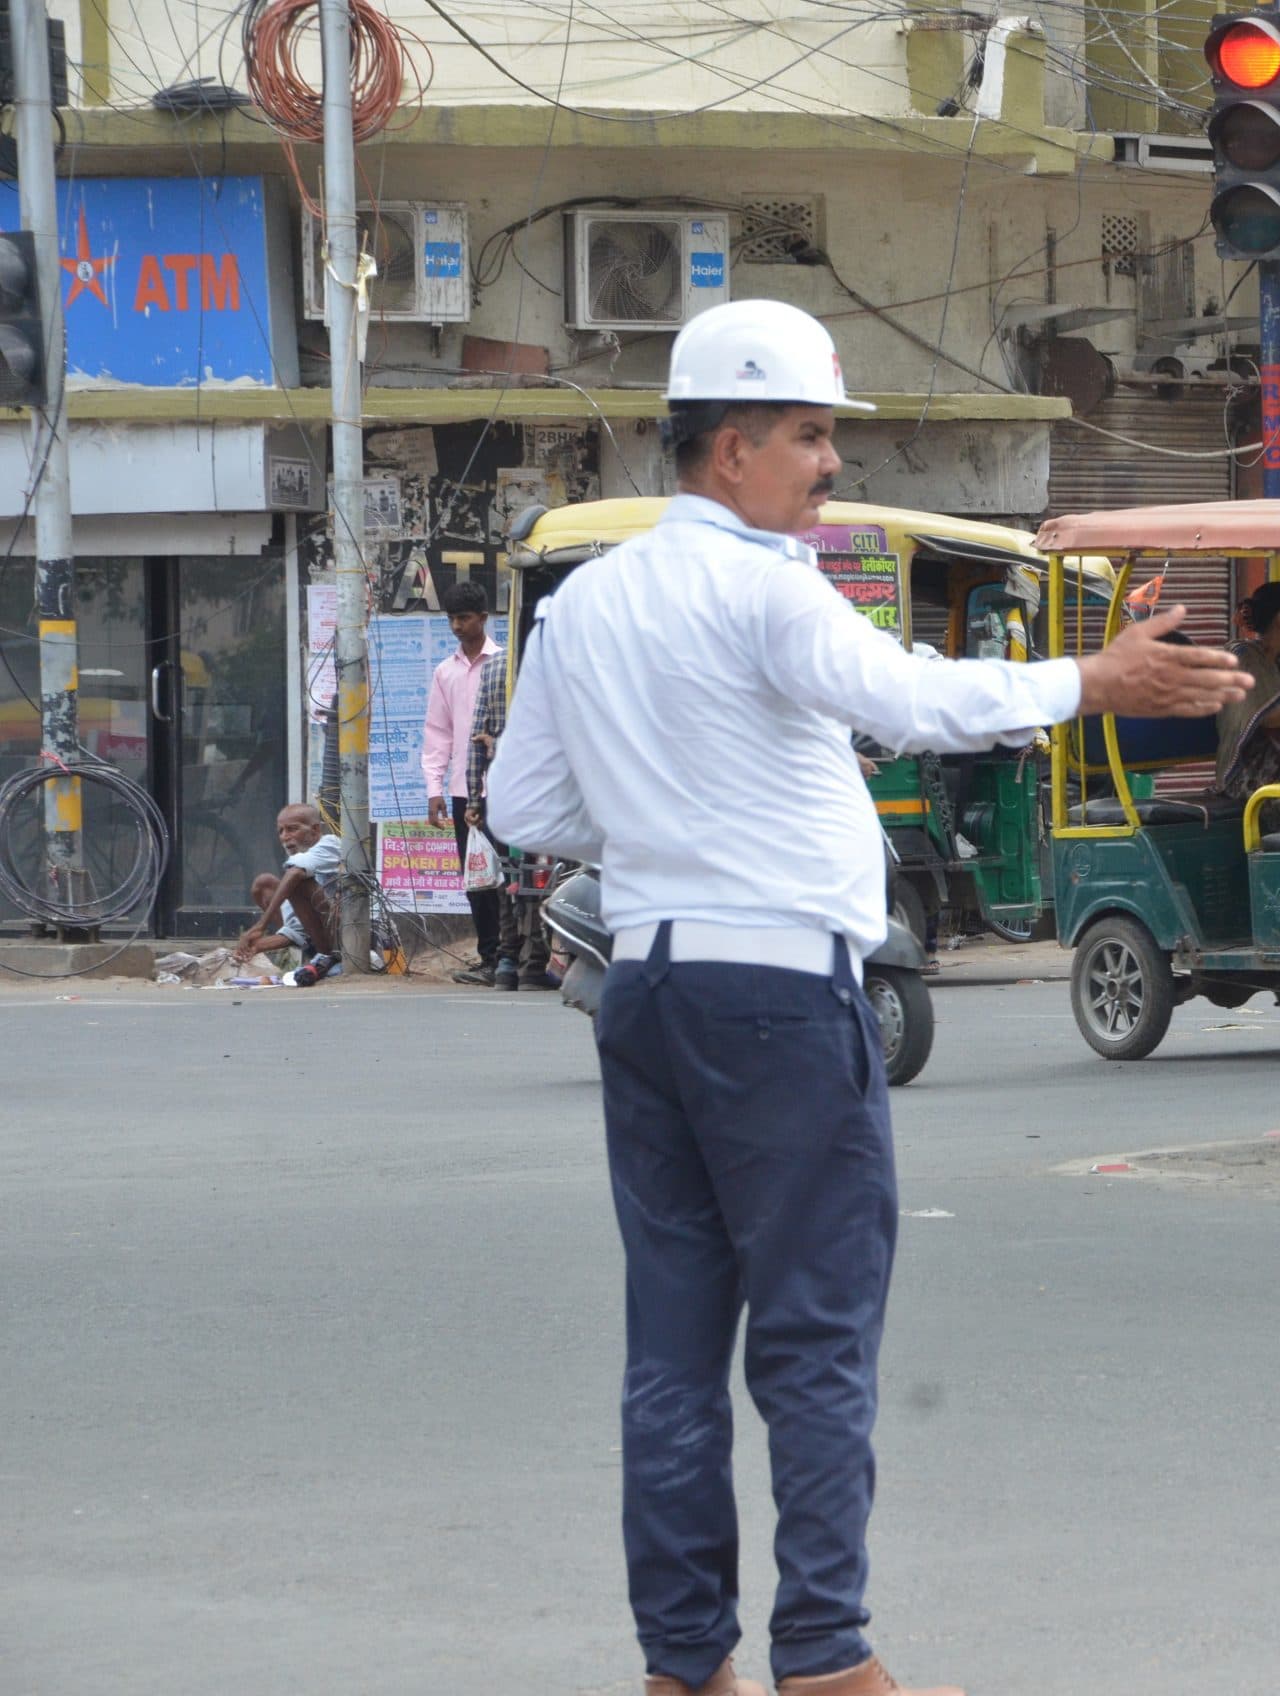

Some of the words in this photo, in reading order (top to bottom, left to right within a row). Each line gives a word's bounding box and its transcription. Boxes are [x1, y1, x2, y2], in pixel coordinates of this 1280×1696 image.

[425, 255, 461, 267] Haier
[691, 264, 723, 277] Haier
[134, 254, 241, 312] ATM
[853, 534, 879, 548] CITI
[383, 856, 438, 870] SPOKEN
